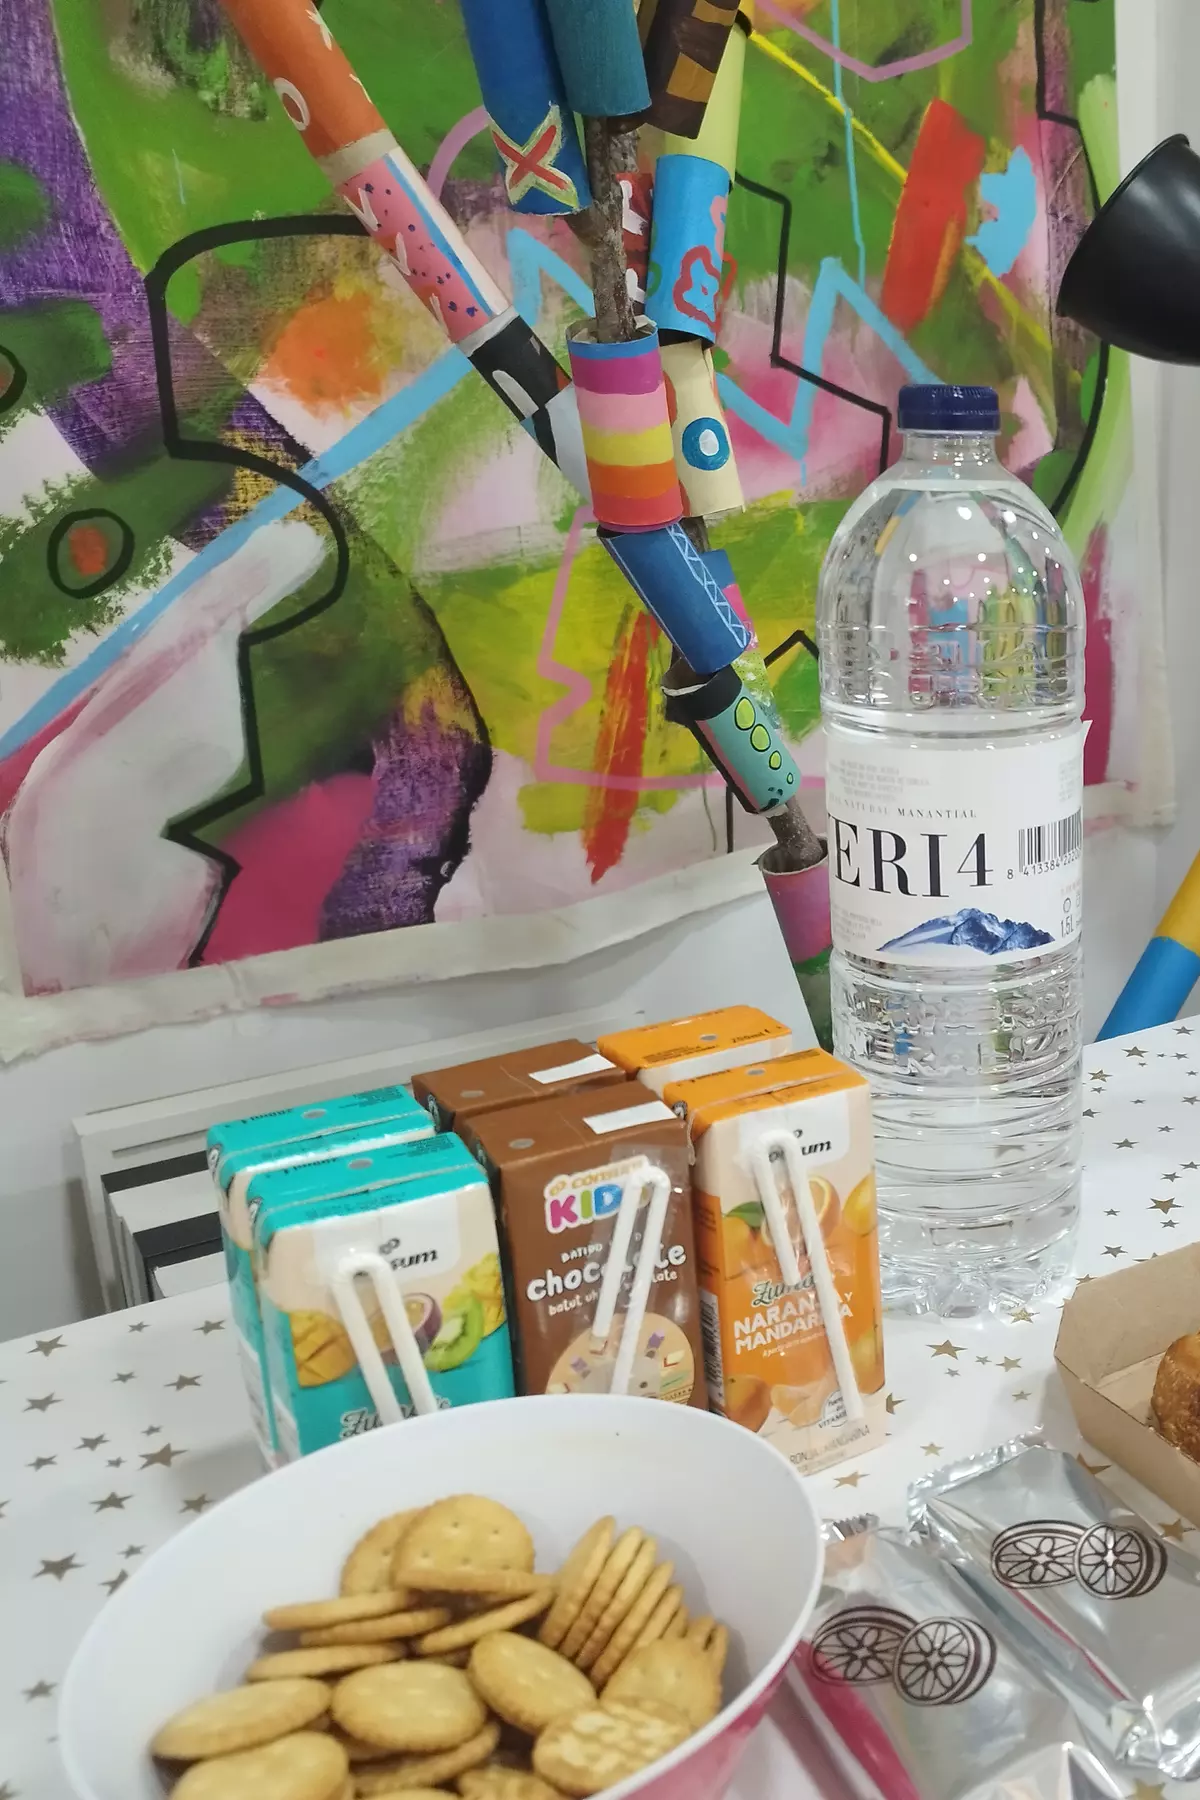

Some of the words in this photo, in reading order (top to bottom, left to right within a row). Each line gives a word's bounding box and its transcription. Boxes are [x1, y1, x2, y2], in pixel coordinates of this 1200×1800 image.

[897, 808, 977, 819] MANANTIAL
[828, 813, 994, 898] ERI4
[843, 1292, 853, 1302] Y
